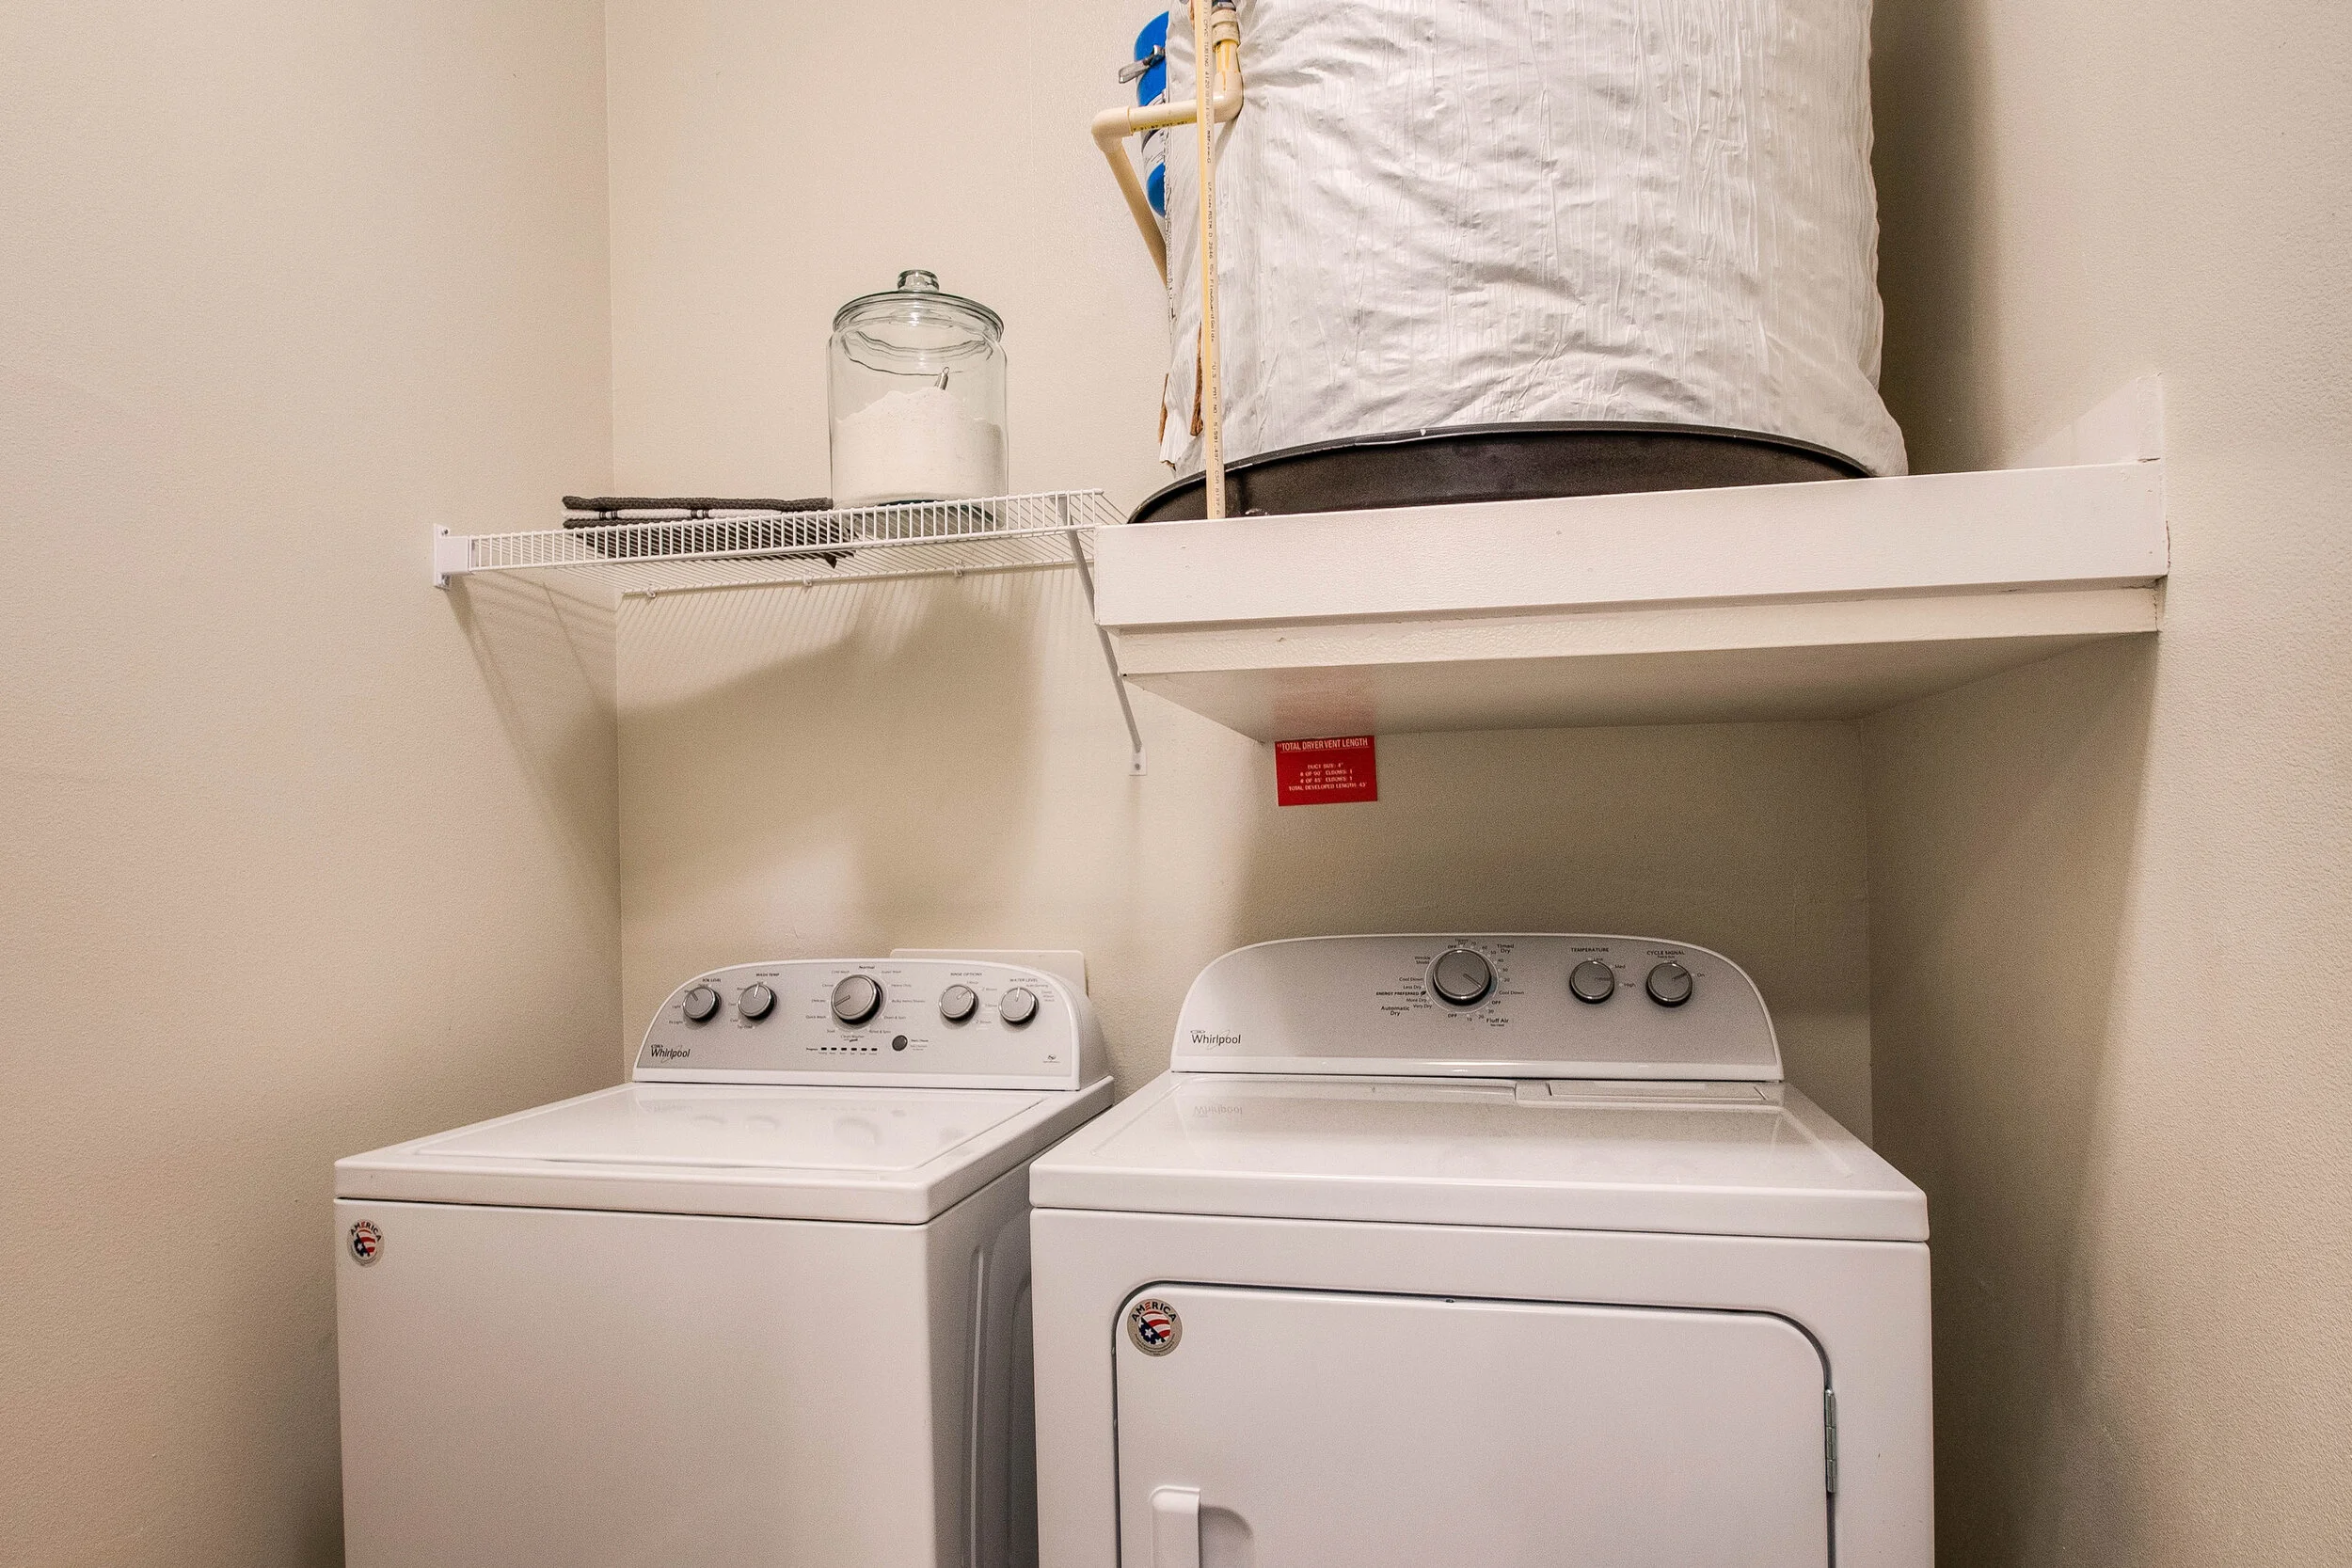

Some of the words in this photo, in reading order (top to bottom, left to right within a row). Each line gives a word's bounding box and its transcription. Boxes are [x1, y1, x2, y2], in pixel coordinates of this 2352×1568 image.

[1282, 742, 1301, 751] TOTAL
[1302, 740, 1324, 750] DRYER
[1324, 739, 1341, 749] VENT
[1342, 738, 1368, 747] LENGTH
[1192, 1034, 1241, 1046] Whirlpool
[651, 1048, 691, 1060] Whirlpool
[350, 1221, 381, 1242] AMERICA
[1131, 1301, 1177, 1322] AMERICA
